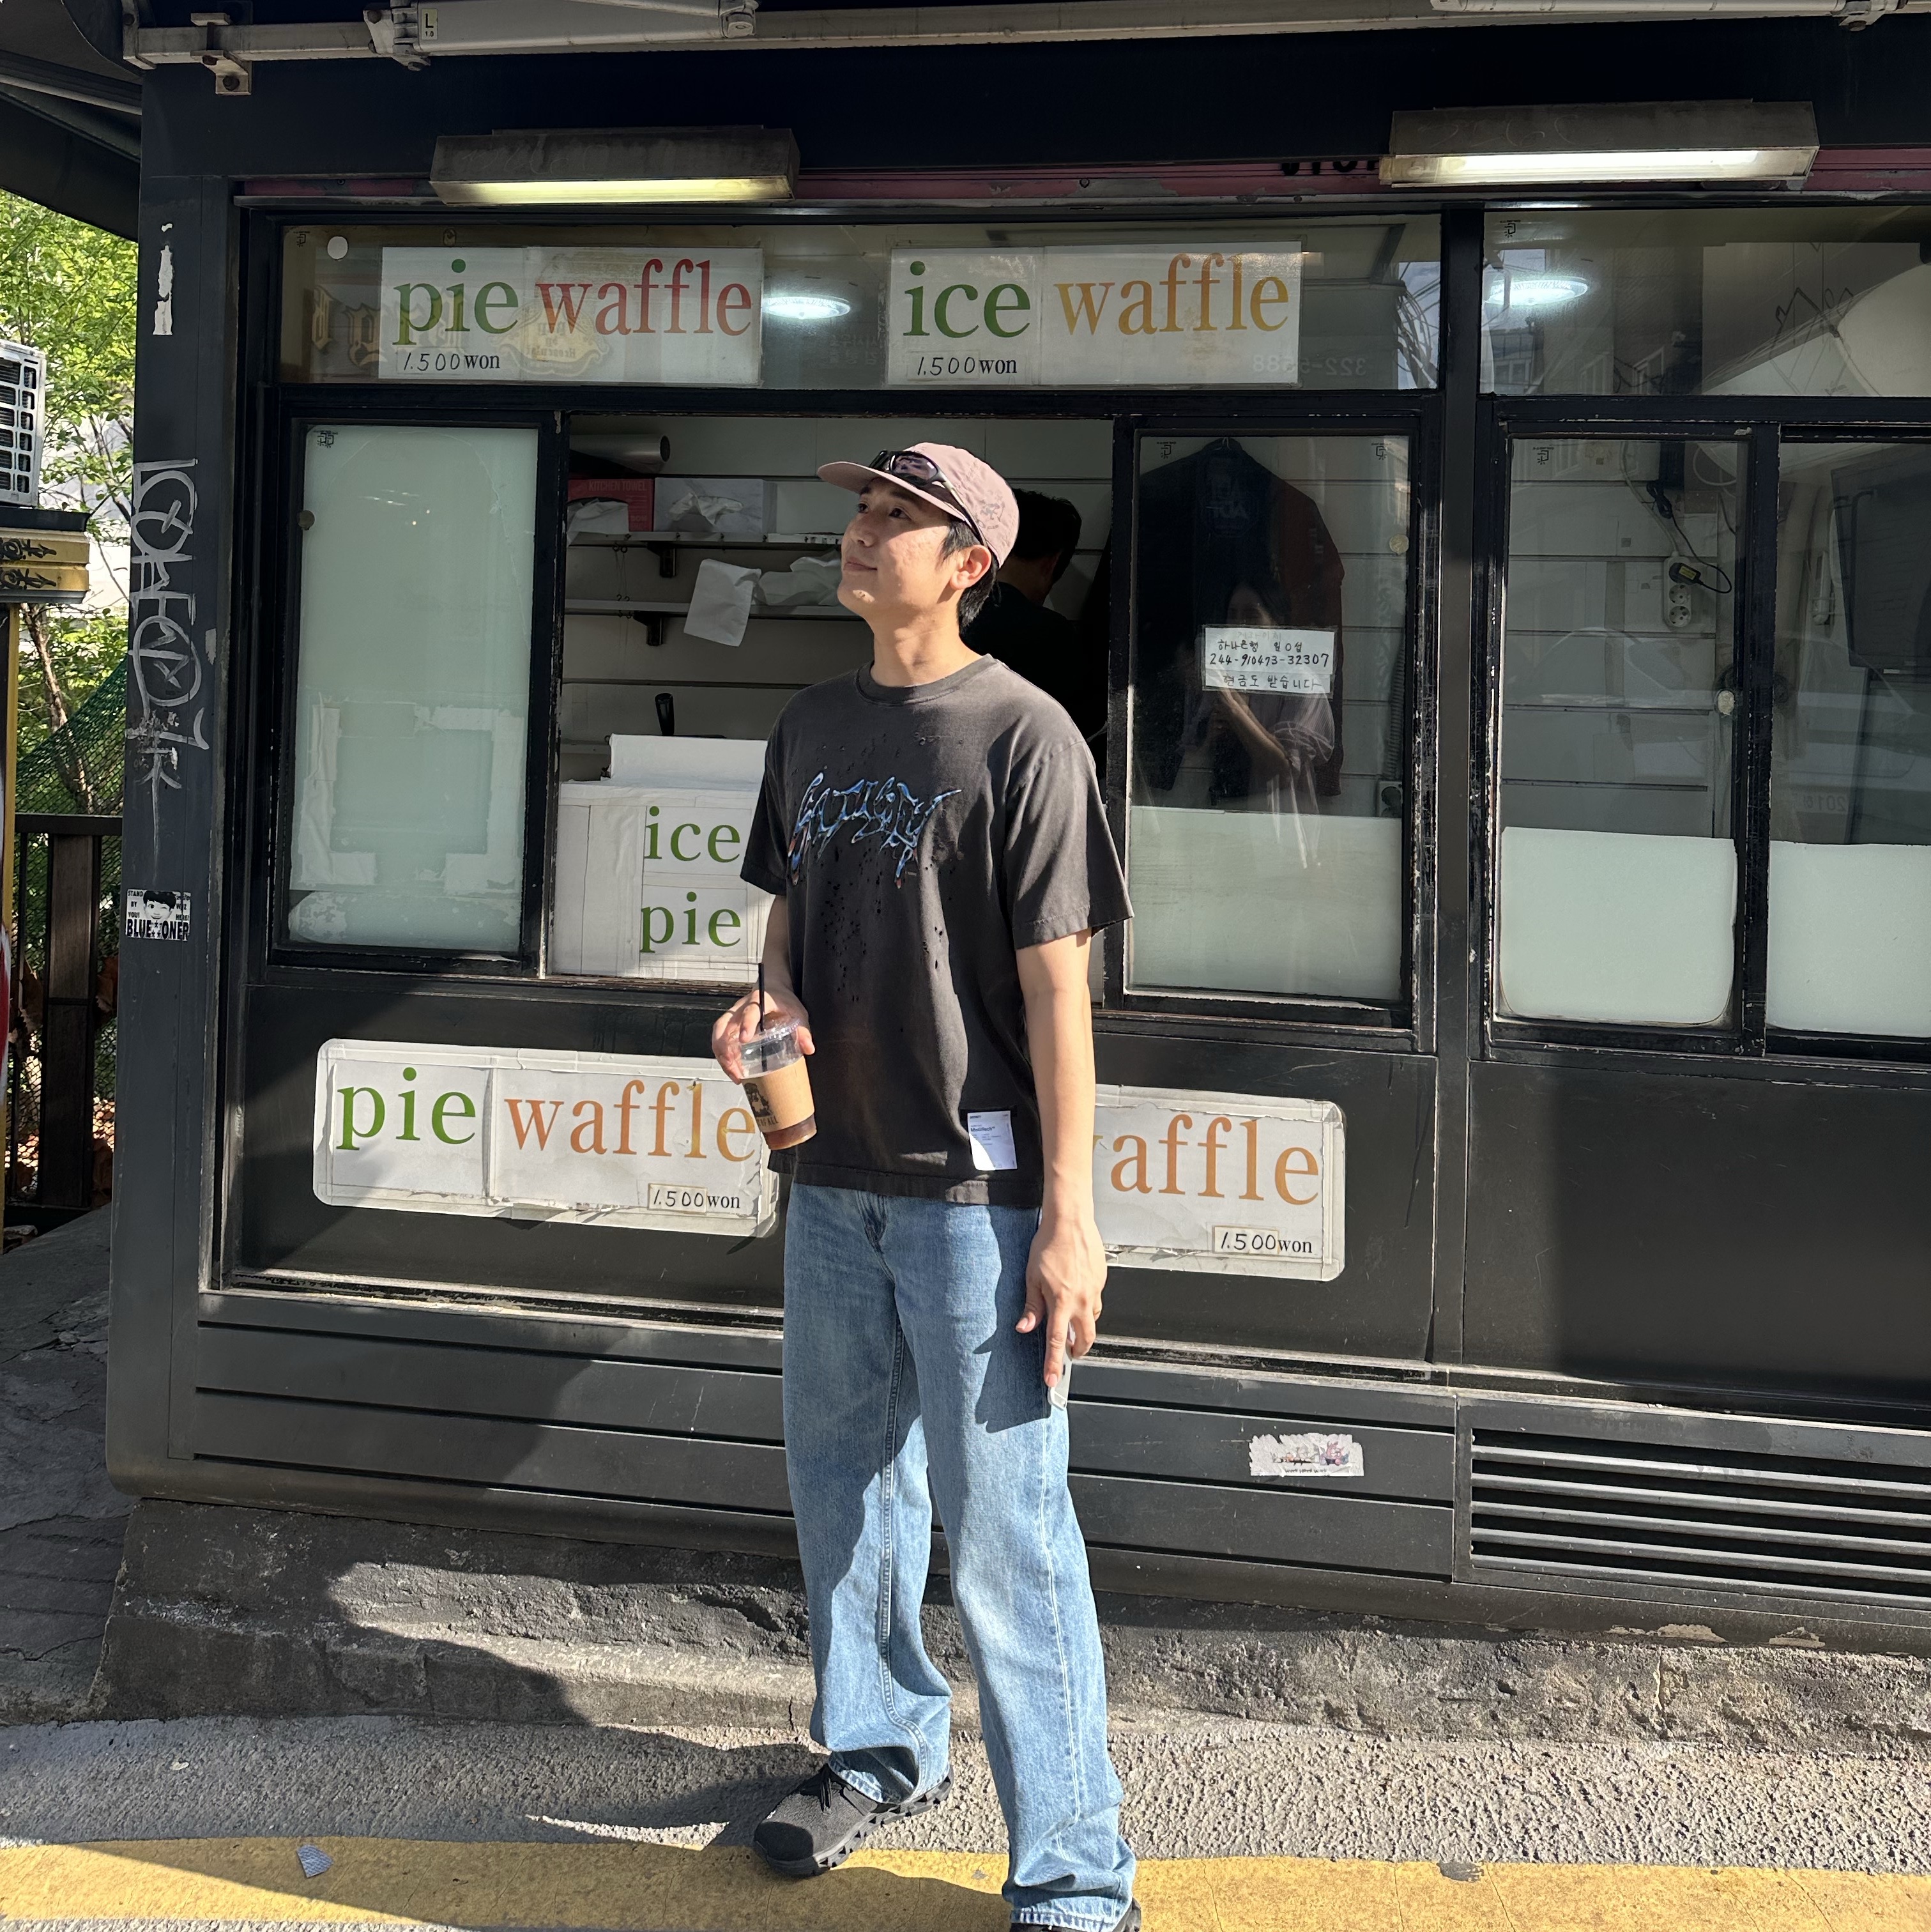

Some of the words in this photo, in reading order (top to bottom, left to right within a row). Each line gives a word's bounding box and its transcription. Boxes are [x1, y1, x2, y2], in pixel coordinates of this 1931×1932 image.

[425, 12, 434, 29] L
[392, 259, 519, 346] pie
[534, 258, 752, 336] waffle
[903, 261, 1031, 338] ice
[1055, 252, 1289, 335] waffle
[589, 480, 620, 491] KITCHEN
[622, 480, 647, 491] TOWEL
[1209, 653, 1329, 667] 244-910473-32307
[1217, 639, 1258, 652] 하나은행
[1223, 673, 1260, 688] 현금도
[1267, 675, 1322, 691] 받습니다
[644, 806, 740, 862] ice
[640, 891, 741, 953] pie
[335, 1067, 476, 1151] pie
[505, 1078, 756, 1162] waffle
[1093, 1114, 1319, 1206] affle
